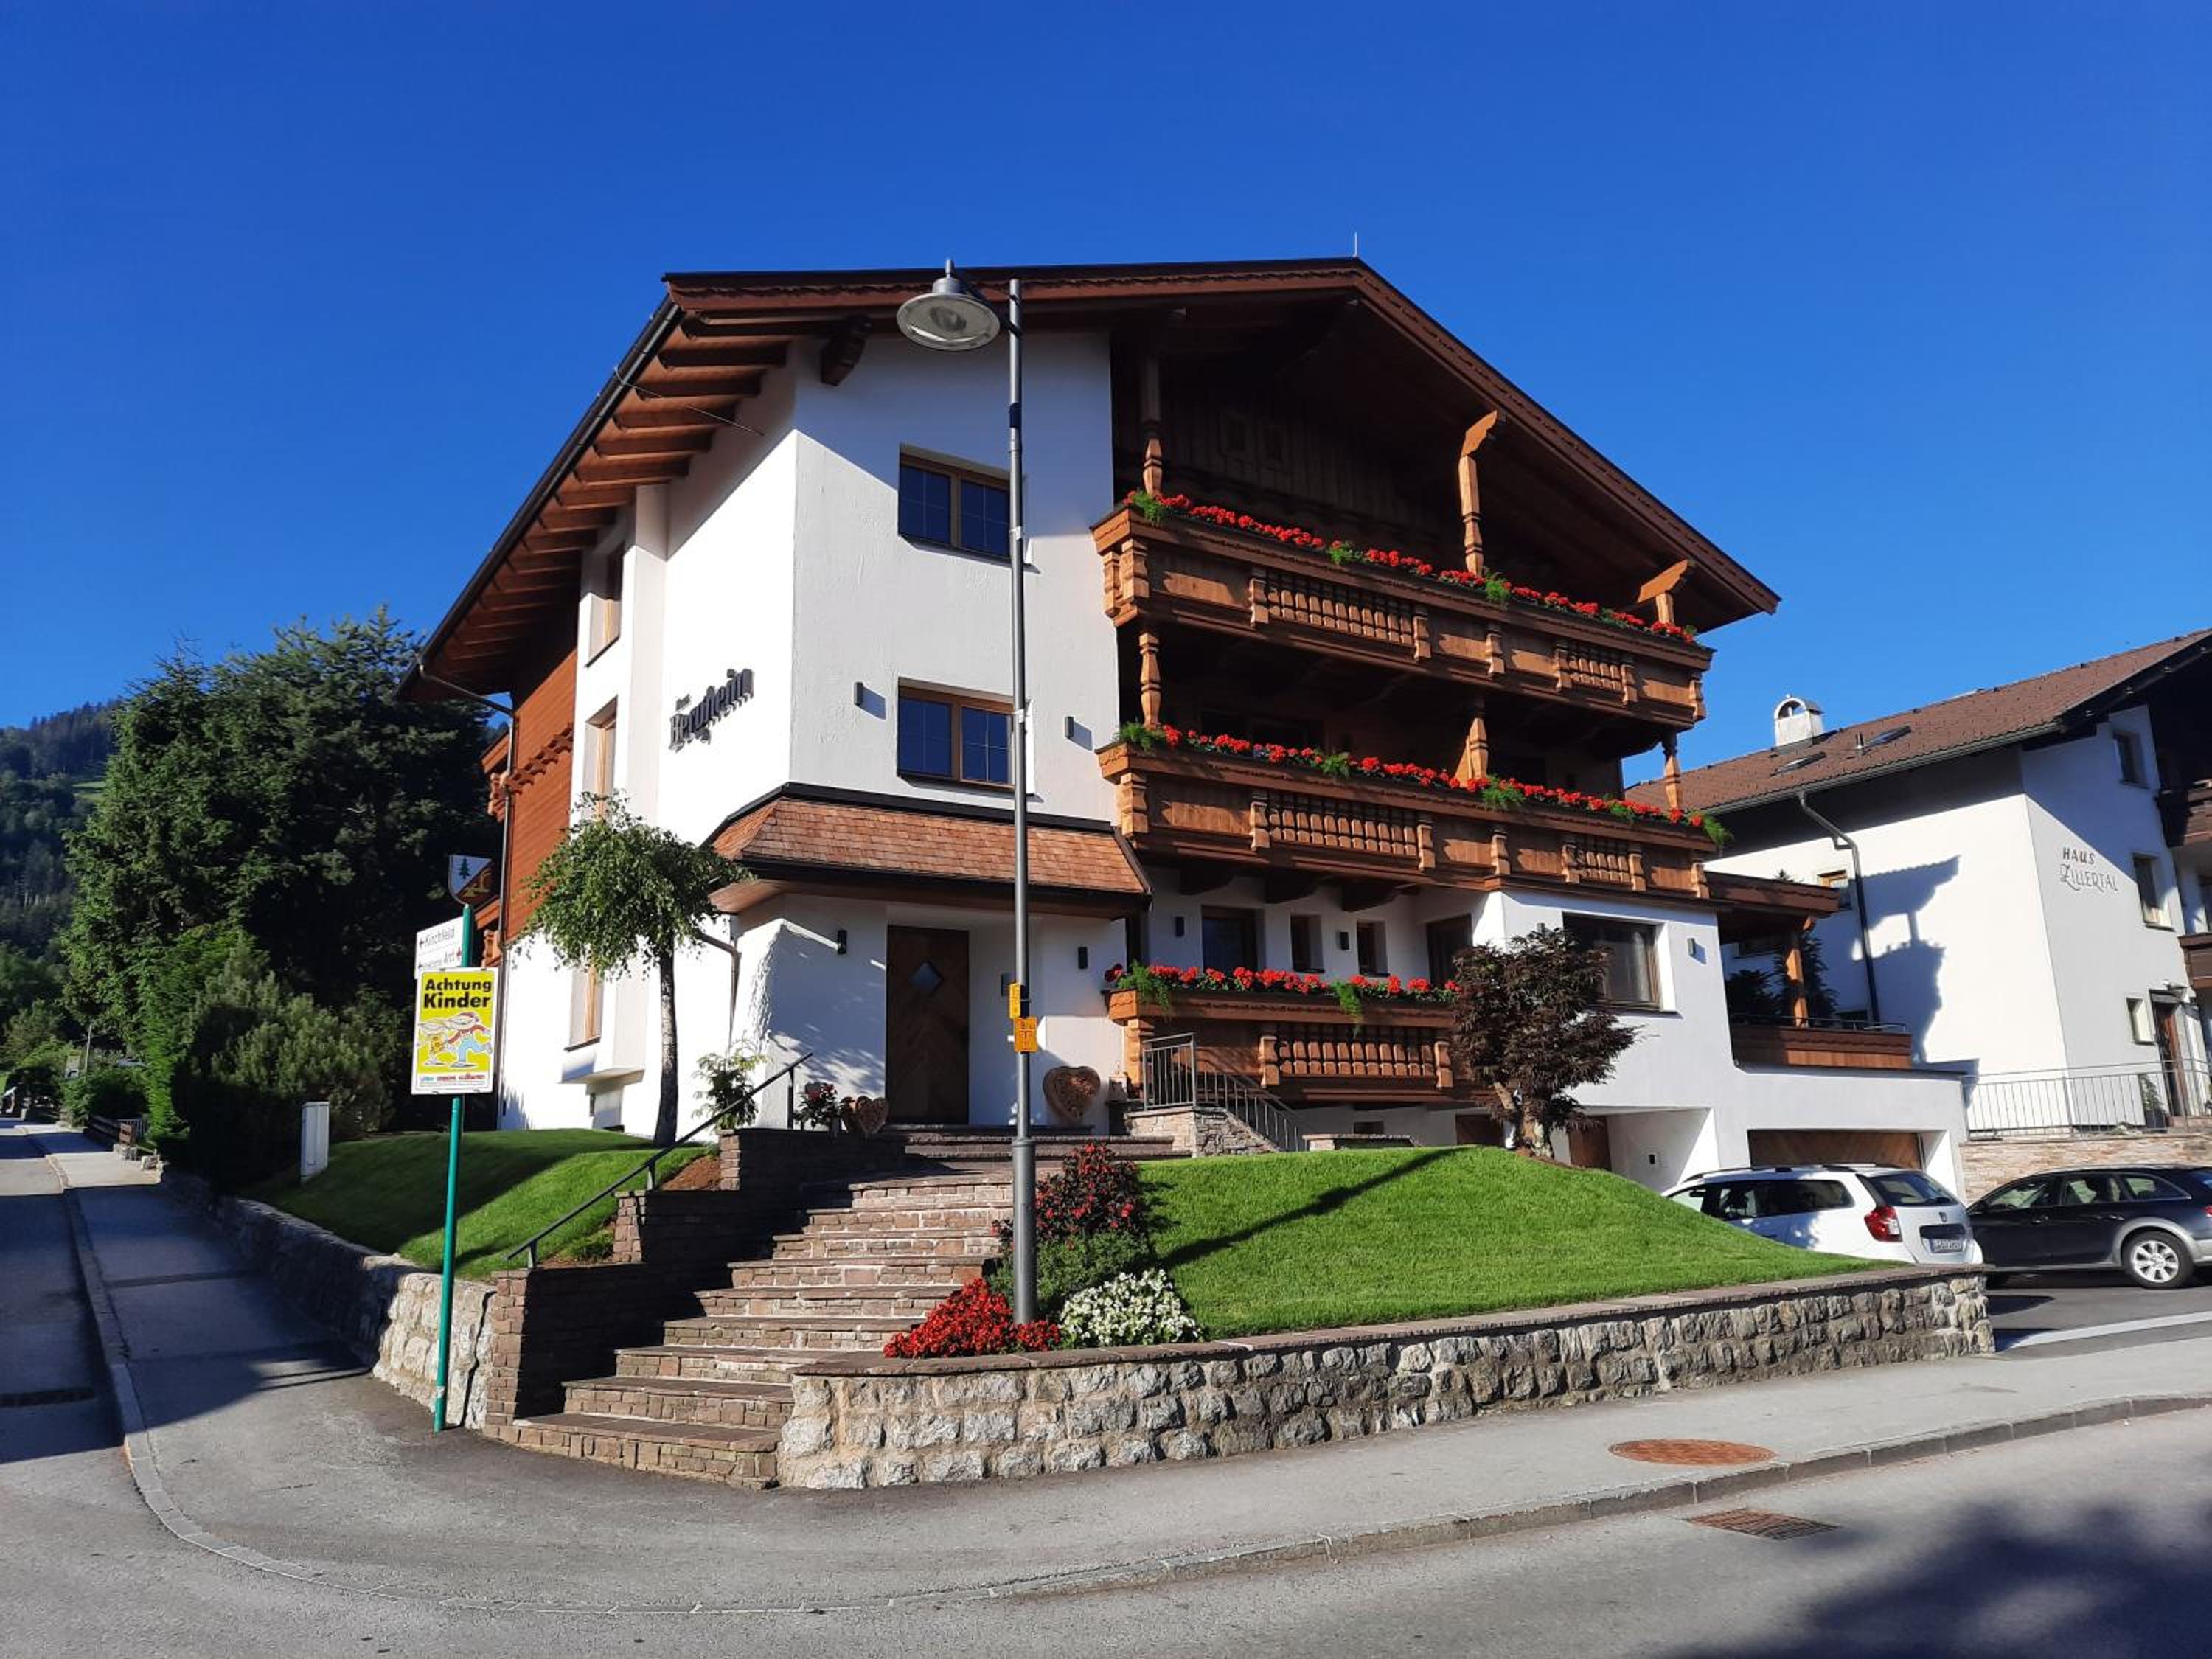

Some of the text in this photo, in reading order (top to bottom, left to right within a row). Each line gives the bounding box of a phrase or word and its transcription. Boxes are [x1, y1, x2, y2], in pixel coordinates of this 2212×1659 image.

[2062, 847, 2096, 865] HAUS
[2059, 863, 2119, 893] ZILLERTAL
[425, 978, 492, 992] Achtung
[424, 992, 490, 1009] Kinder
